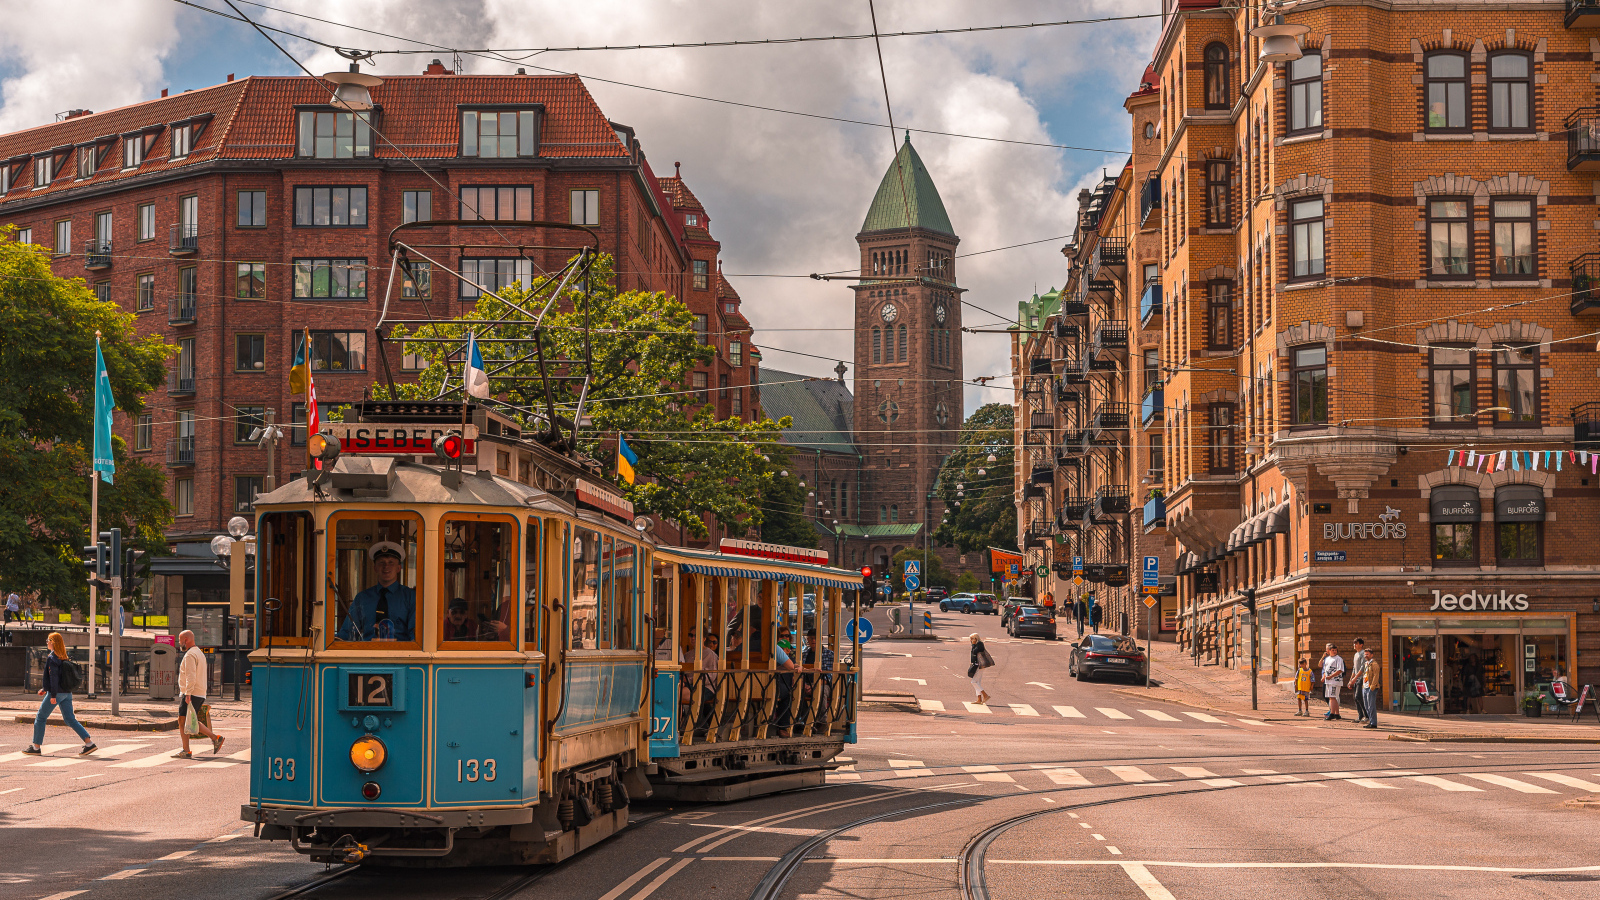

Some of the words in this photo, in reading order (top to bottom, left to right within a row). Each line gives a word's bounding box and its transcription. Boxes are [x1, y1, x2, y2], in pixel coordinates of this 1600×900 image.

[329, 428, 462, 448] ISEBER
[1442, 507, 1474, 515] BJURFORS
[1507, 506, 1540, 514] BJURFORS
[446, 527, 451, 535] 3
[1323, 522, 1407, 542] BJURFORS
[735, 541, 818, 563] LISEBERGSLINJEN
[1075, 557, 1081, 565] P
[1147, 558, 1156, 570] P
[1430, 589, 1529, 611] Jedviks
[357, 675, 386, 704] 12
[268, 756, 296, 781] 133
[457, 758, 497, 783] 133
